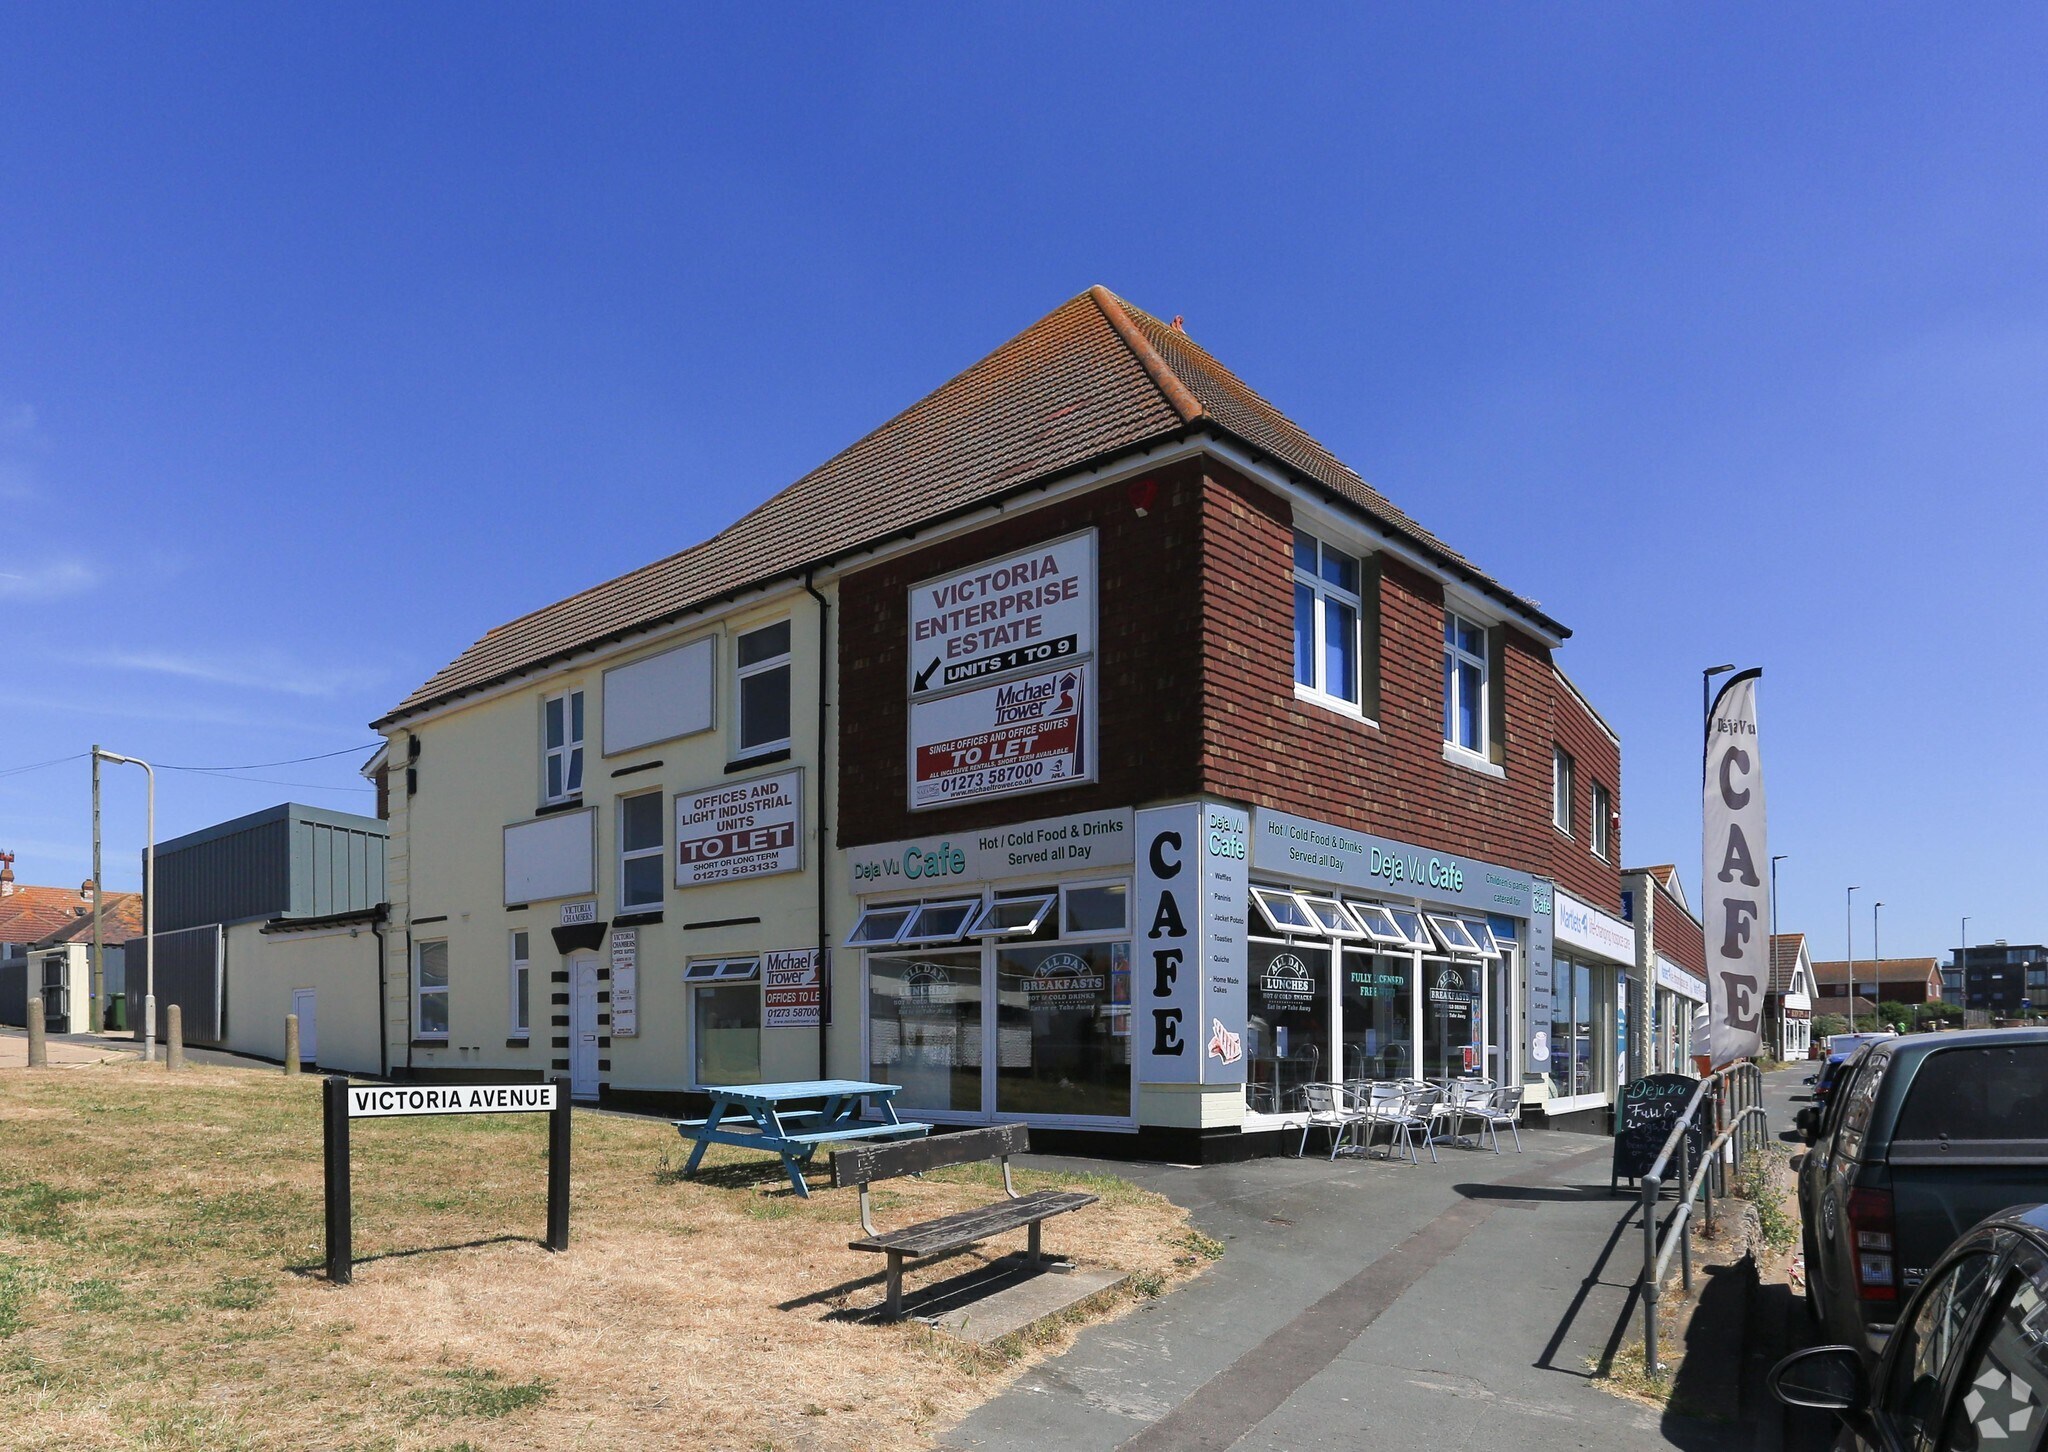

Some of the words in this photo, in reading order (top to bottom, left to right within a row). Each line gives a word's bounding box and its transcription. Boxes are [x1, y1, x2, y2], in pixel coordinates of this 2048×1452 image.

[932, 555, 1059, 608] VICTORIA
[915, 576, 1078, 641] ENTERPRISE
[947, 615, 1042, 659] ESTATE
[948, 658, 1001, 680] UNITS
[1008, 653, 1016, 665] 1
[1025, 645, 1051, 661] TO
[1058, 640, 1070, 653] 9
[996, 676, 1056, 707] Michael
[995, 701, 1047, 724] Trower
[929, 742, 955, 755] SINGLE
[957, 734, 988, 749] OFFICES
[990, 731, 1006, 743] AND
[1008, 725, 1036, 739] OFFICE
[1038, 718, 1069, 732] SUITES
[951, 747, 982, 767] TO
[990, 736, 1039, 761] LET
[929, 771, 939, 779] ALL
[940, 766, 969, 778] INCLUSIVE
[998, 758, 1018, 766] SHORT
[1018, 754, 1035, 762] TERM
[1036, 747, 1069, 759] AVAILABLE
[941, 773, 983, 792] 01273
[988, 762, 1043, 784] 587000
[694, 789, 747, 810] OFFICES
[751, 782, 779, 798] AND
[950, 778, 1033, 798] www.michaeltrower.co.uk
[682, 810, 716, 826] LIGHT
[718, 794, 792, 818] INDUSTRIAL
[716, 816, 754, 832] UNITS
[1210, 813, 1230, 833] Deja
[1231, 818, 1243, 834] Vu
[684, 838, 724, 860] TO
[732, 826, 789, 853] LET
[979, 837, 999, 851] Hot
[1008, 831, 1034, 847] Cold
[1037, 826, 1067, 843] Food
[1070, 824, 1080, 838] &
[1083, 818, 1124, 836] Drinks
[1268, 820, 1283, 836] Hot
[1290, 826, 1308, 842] Cold
[1310, 830, 1330, 847] Food
[1332, 836, 1338, 848] &
[1339, 837, 1363, 855] Drinks
[1008, 850, 1048, 866] Served
[1051, 846, 1064, 860] all
[1068, 844, 1092, 860] Day
[1208, 830, 1246, 861] Cafe
[694, 861, 718, 871] SHORT
[720, 858, 732, 866] OR
[733, 856, 754, 866] LONG
[756, 852, 779, 860] TERM
[694, 868, 728, 880] 01273
[732, 861, 778, 874] 583133
[854, 862, 881, 882] Deja
[882, 858, 900, 875] Vu
[903, 842, 966, 880] Cafe
[1289, 848, 1317, 864] Served
[1318, 854, 1328, 866] all
[1330, 856, 1344, 873] Day
[1370, 846, 1404, 886] Deja
[1406, 854, 1425, 884] Vu
[1428, 857, 1464, 892] Cafe
[1215, 872, 1232, 882] Waffles
[1512, 881, 1530, 892] parties
[1214, 893, 1231, 902] Paninis
[1718, 745, 1760, 1033] CAFE
[564, 904, 592, 914] VICTORIA
[1532, 896, 1551, 916] Cafe
[563, 912, 592, 924] CHAMBERS
[1214, 914, 1230, 922] Jacket
[1230, 916, 1244, 924] Potato
[1560, 904, 1582, 934] Martlets
[612, 940, 636, 948] CHAMBERS
[614, 932, 634, 940] VICTORIA
[1148, 831, 1187, 1056] CAFE
[1214, 934, 1232, 943] Toasties
[767, 952, 811, 970] Michael
[1040, 958, 1059, 976] ALL
[1062, 956, 1087, 973] DAY
[1214, 954, 1230, 964] Quiche
[1272, 957, 1286, 975] ALL
[1288, 957, 1304, 976] DAY
[766, 971, 804, 984] Trower
[904, 966, 921, 982] ALL
[924, 964, 945, 980] DAY
[1213, 976, 1226, 984] Home
[1351, 972, 1372, 984] FULLY
[1022, 978, 1102, 991] BREAKFASTS
[1213, 986, 1227, 994] Cakes
[1266, 978, 1308, 991] LUNCHES
[766, 992, 796, 1004] OFFICES
[799, 992, 808, 1002] TO
[810, 992, 820, 1002] LE
[1068, 992, 1096, 1000] DRINKS
[1431, 990, 1470, 1002] BREAKFASTS
[768, 1008, 790, 1018] 01273
[356, 1090, 462, 1110] VICTORIA
[469, 1088, 550, 1108] AVENUE
